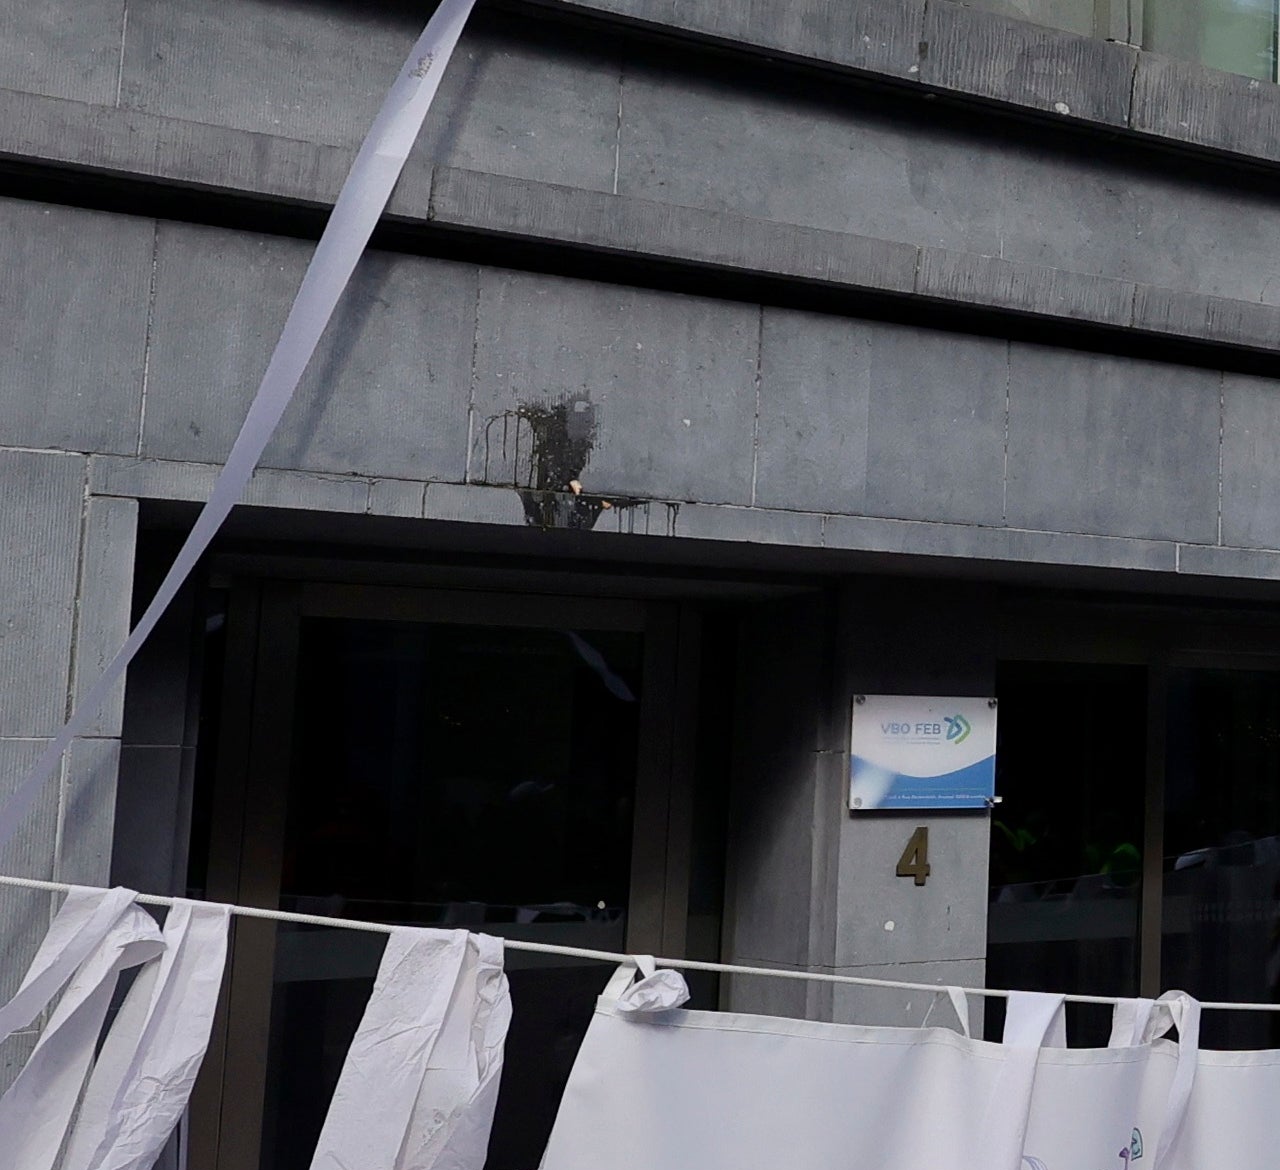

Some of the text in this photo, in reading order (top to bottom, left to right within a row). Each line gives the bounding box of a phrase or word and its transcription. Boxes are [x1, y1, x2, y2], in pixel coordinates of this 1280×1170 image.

[881, 723, 941, 735] VBO FEB
[895, 826, 931, 887] 4
